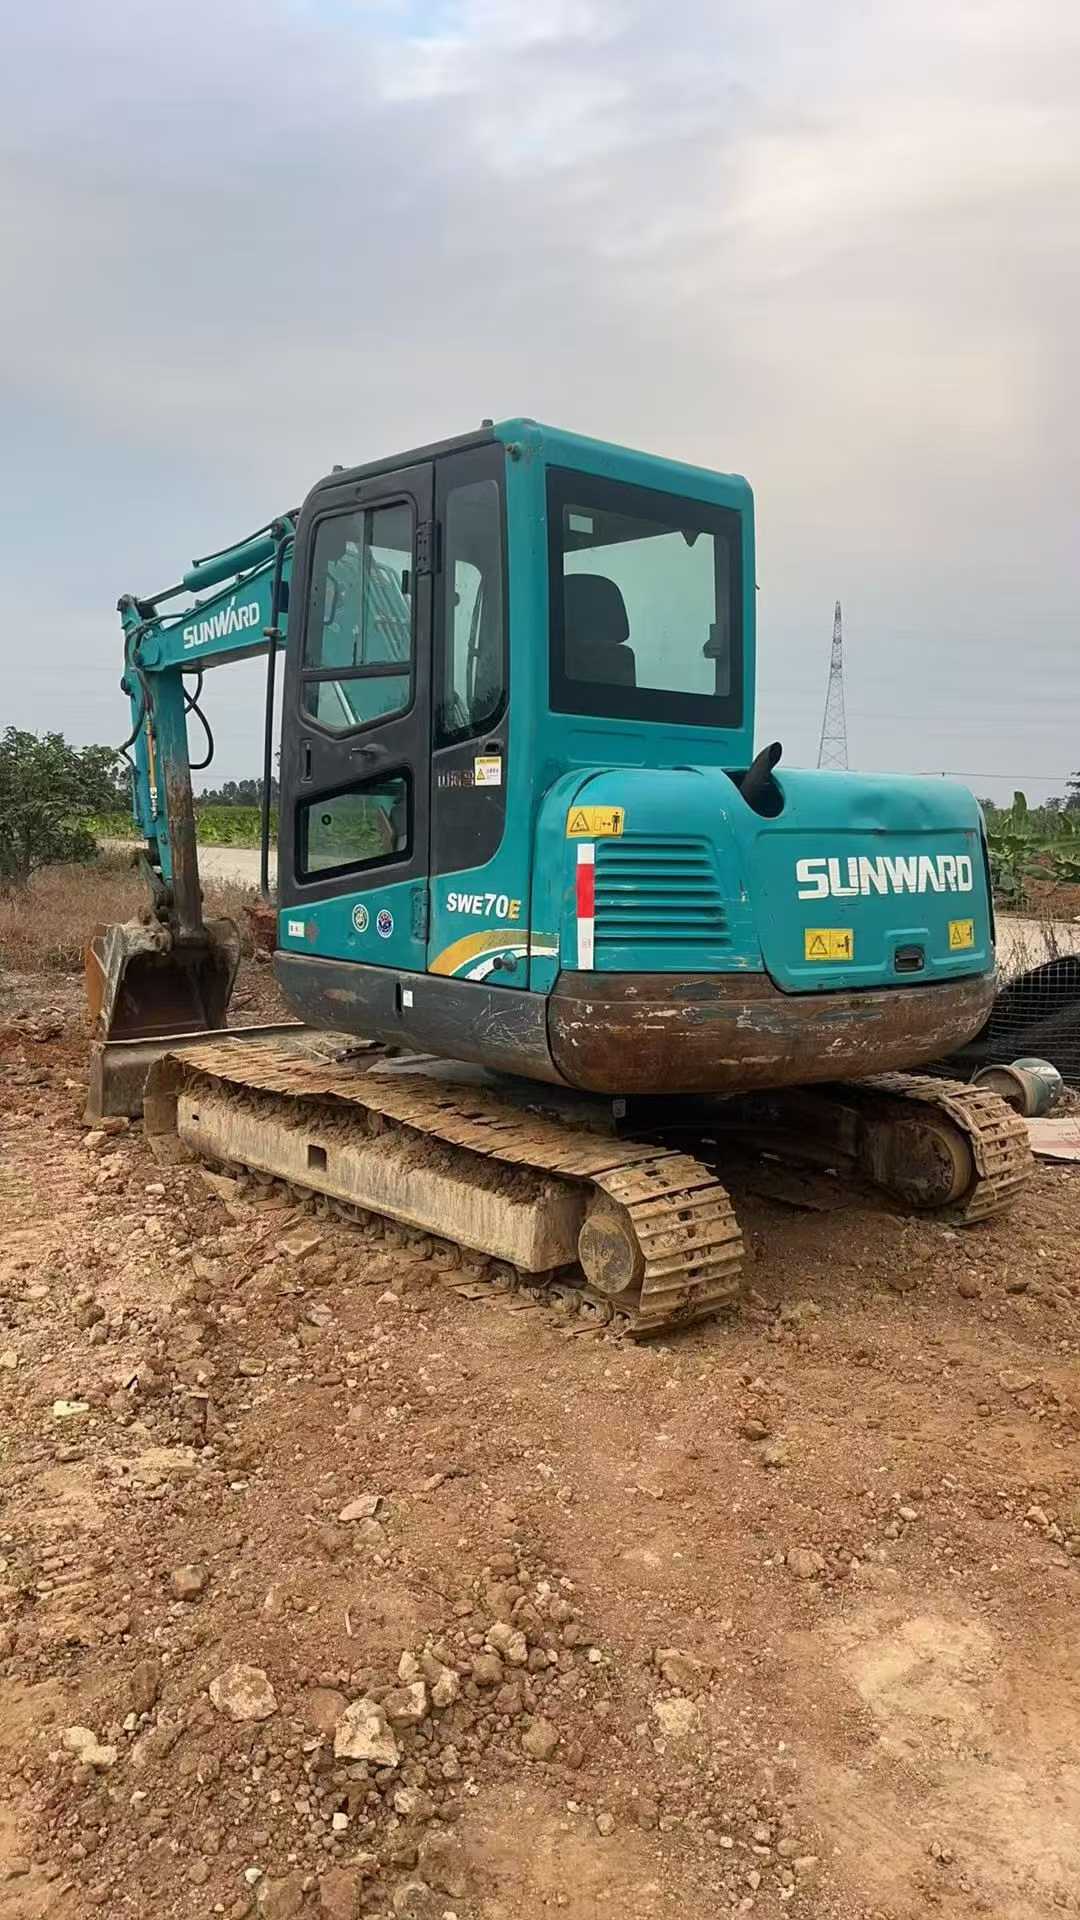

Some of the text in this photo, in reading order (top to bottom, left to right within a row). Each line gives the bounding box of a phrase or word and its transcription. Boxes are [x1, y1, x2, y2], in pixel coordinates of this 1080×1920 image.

[183, 596, 260, 649] SUNWARD
[796, 855, 973, 899] SUNWARD
[446, 892, 521, 919] SWE70E
